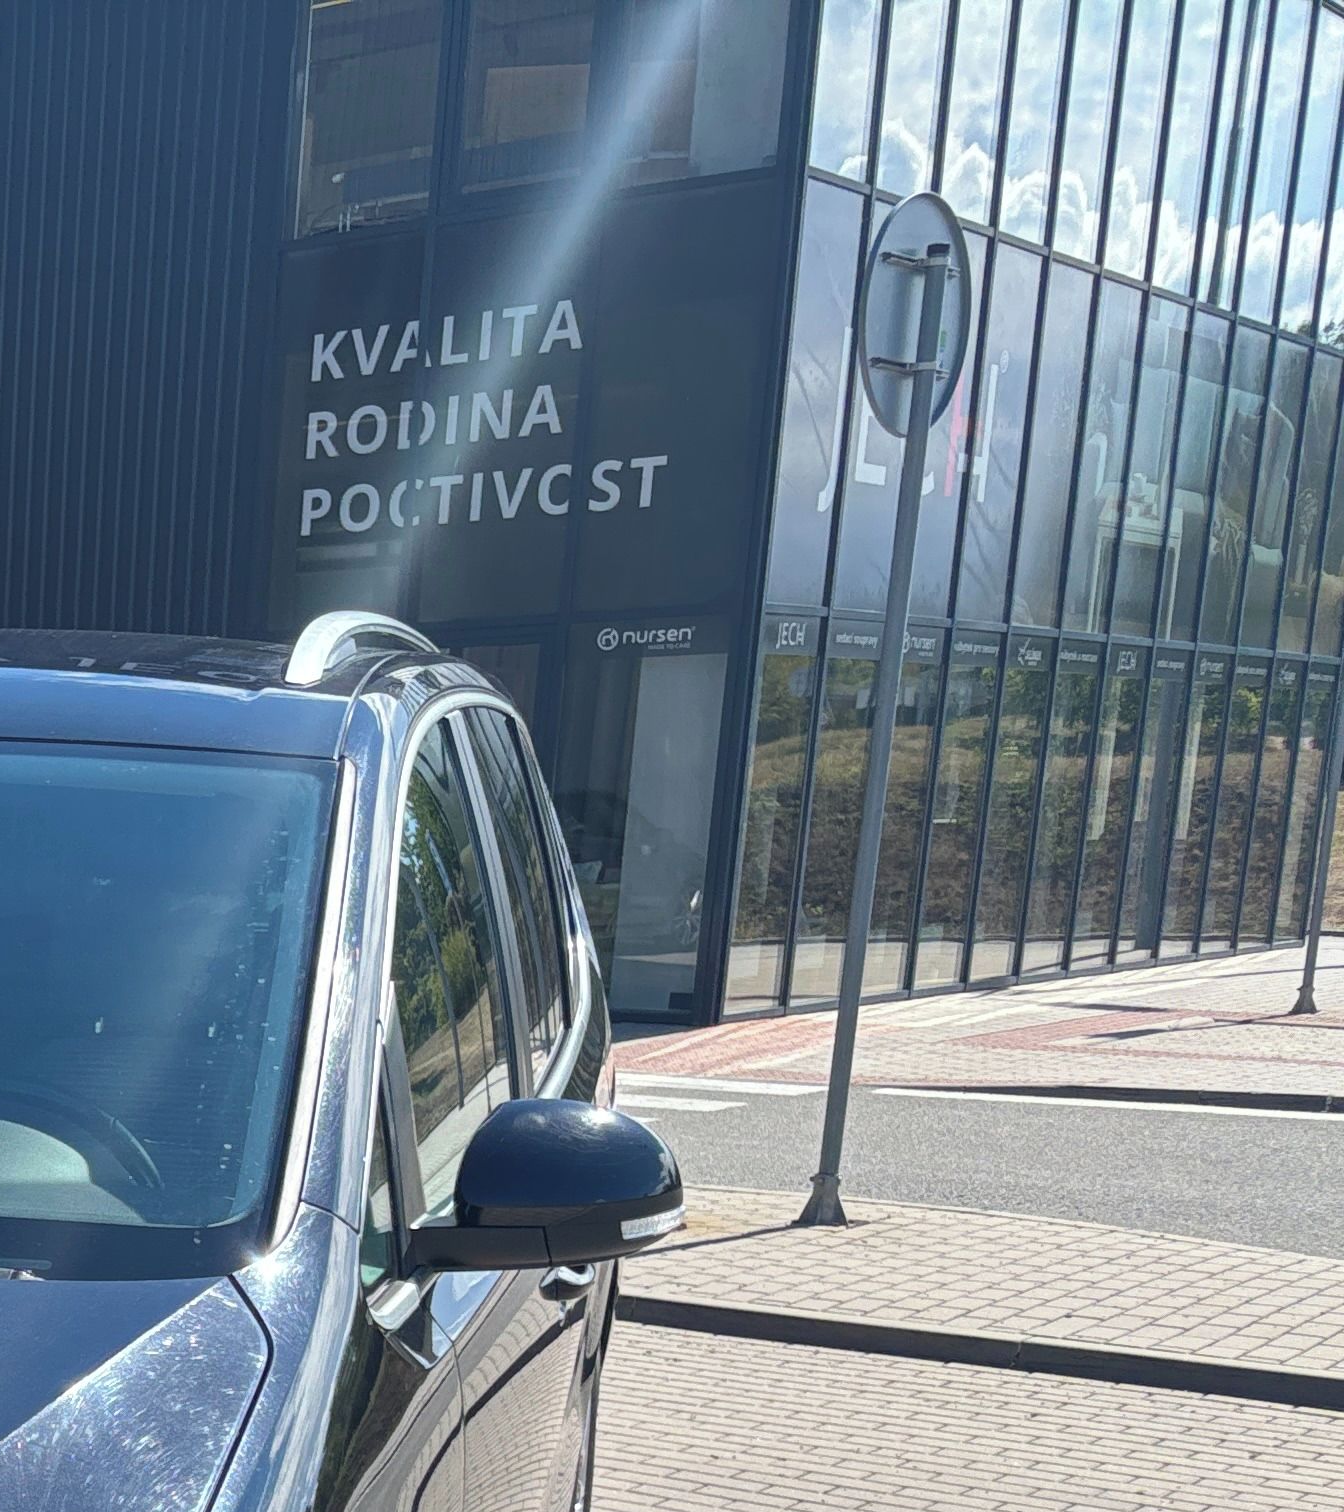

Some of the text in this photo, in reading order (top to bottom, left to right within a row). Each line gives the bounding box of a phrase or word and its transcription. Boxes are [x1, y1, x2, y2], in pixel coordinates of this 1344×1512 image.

[310, 299, 583, 383] KVALITA
[305, 384, 564, 460] RODINA
[622, 627, 692, 645] nursen
[775, 622, 806, 649] JECH
